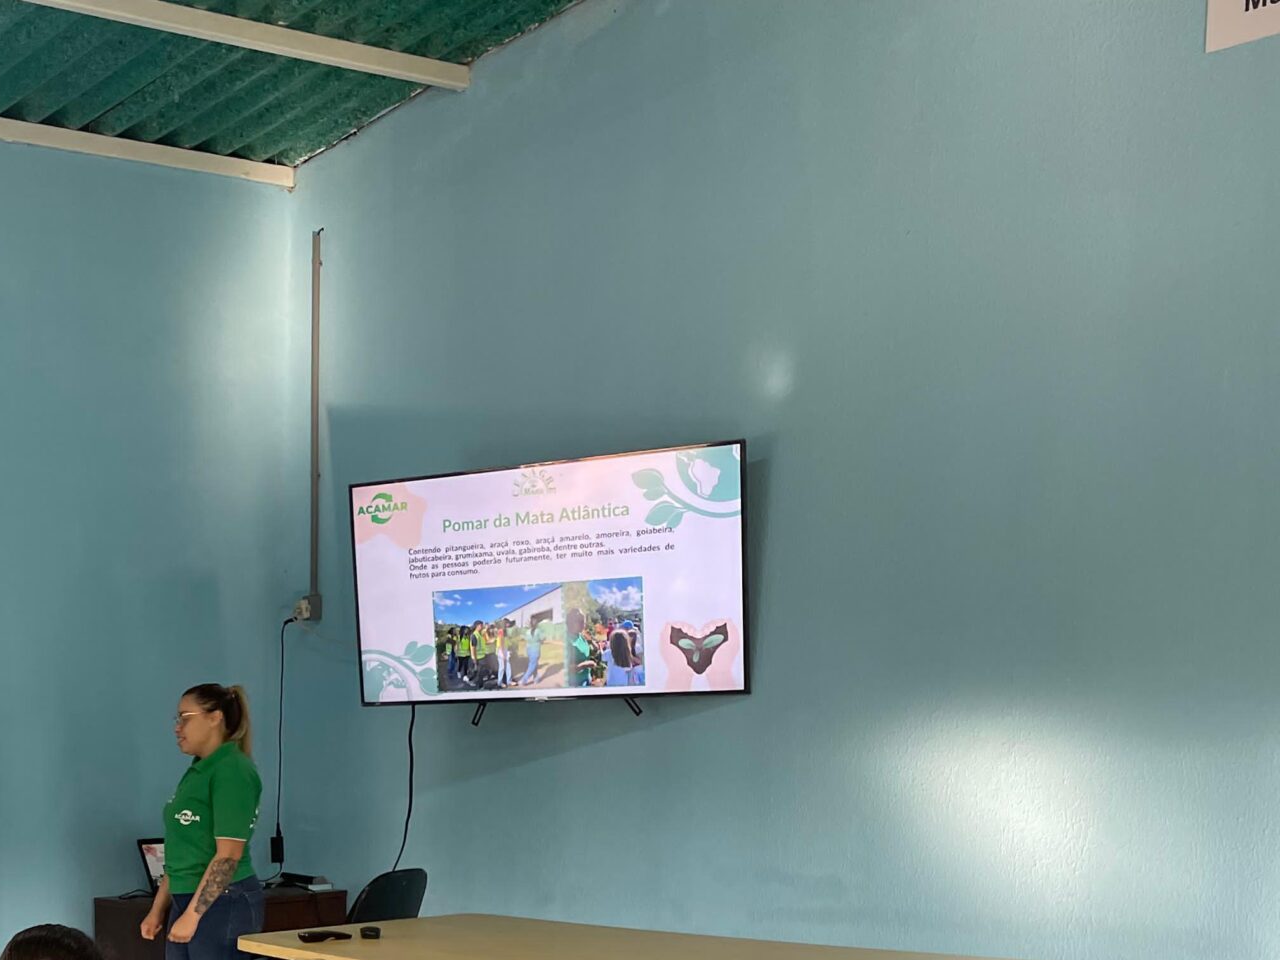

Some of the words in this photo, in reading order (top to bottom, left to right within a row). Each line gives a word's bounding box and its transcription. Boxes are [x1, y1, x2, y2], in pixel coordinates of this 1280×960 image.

[357, 501, 408, 516] ACAMAR
[442, 518, 489, 533] Pomar
[493, 513, 511, 528] da
[516, 510, 554, 526] Mata
[558, 502, 630, 523] Atlântica
[408, 546, 441, 556] Contendo
[595, 530, 631, 540] amoreira,
[636, 526, 675, 537] goiabeira,
[553, 544, 578, 552] dentre
[579, 541, 605, 550] outras.
[409, 563, 428, 571] Onde
[442, 560, 469, 570] pessoas
[472, 557, 502, 567] poderão
[556, 552, 568, 560] ter
[570, 550, 593, 558] muito
[597, 547, 615, 556] mais
[618, 544, 661, 555] variedades
[664, 541, 675, 551] de
[409, 572, 430, 580] frutos
[431, 570, 446, 579] para
[447, 568, 481, 577] consumo.
